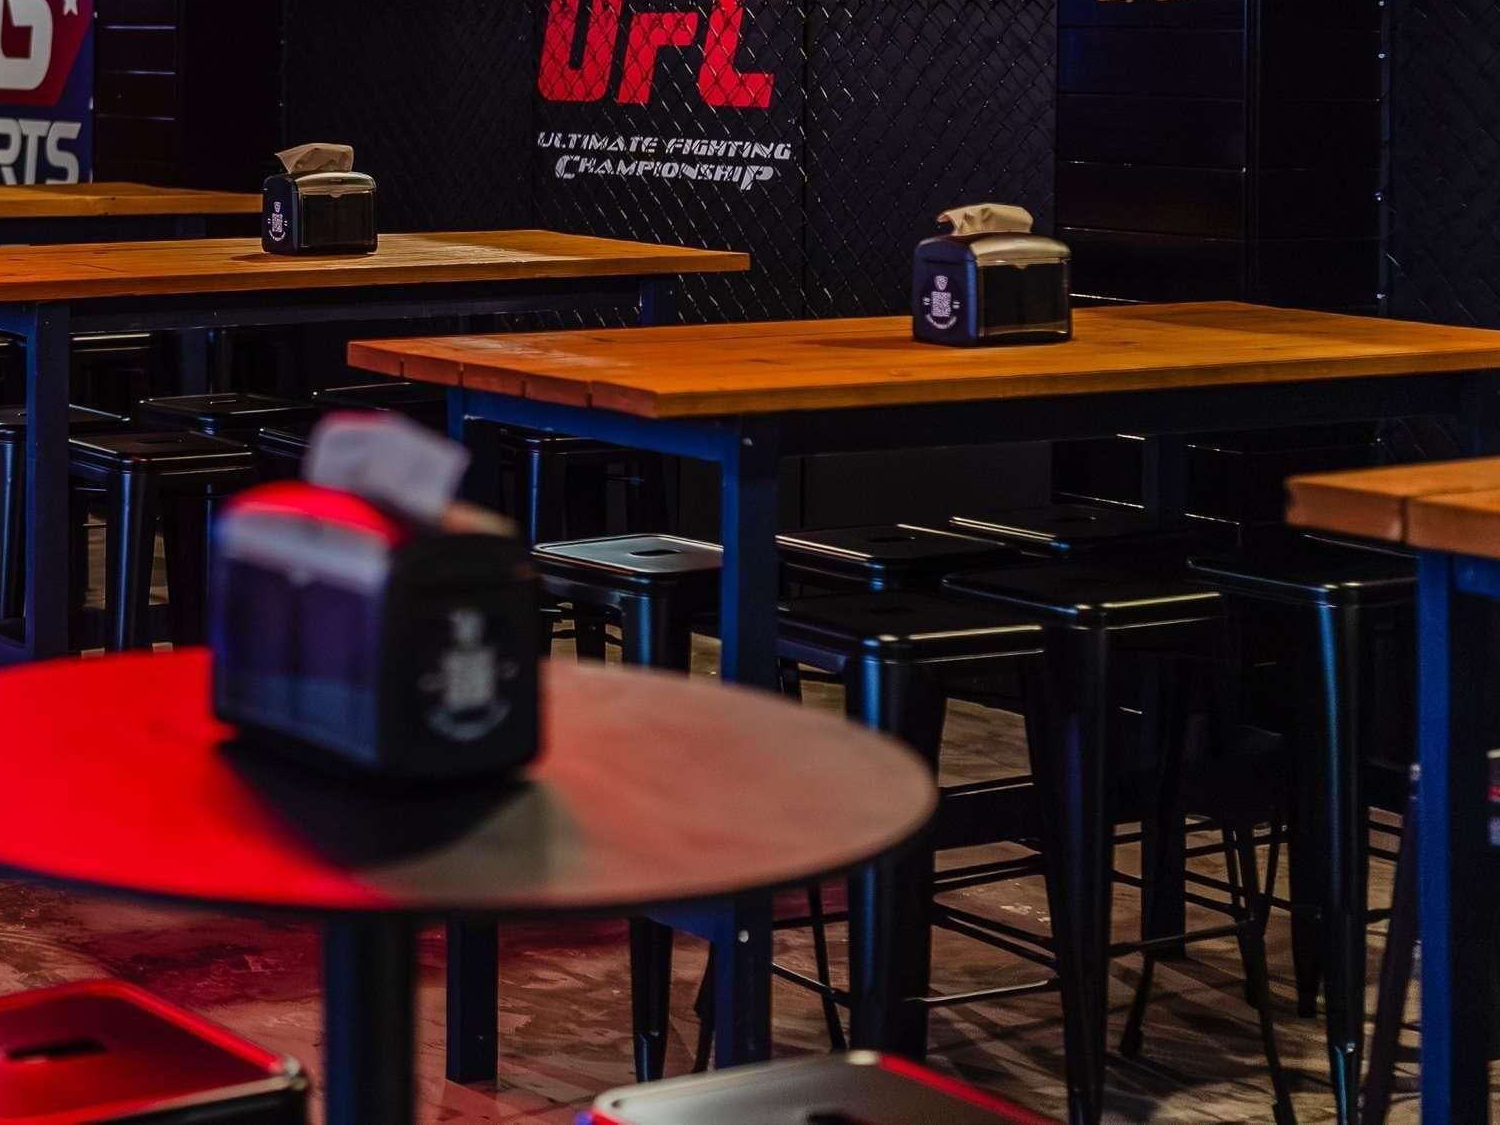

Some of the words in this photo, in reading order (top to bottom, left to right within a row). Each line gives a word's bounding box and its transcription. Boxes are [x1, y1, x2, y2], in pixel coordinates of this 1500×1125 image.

[537, 131, 658, 153] ULTIMATE
[665, 138, 792, 160] FIGHTING
[555, 155, 774, 190] CHAMPIONSHIP
